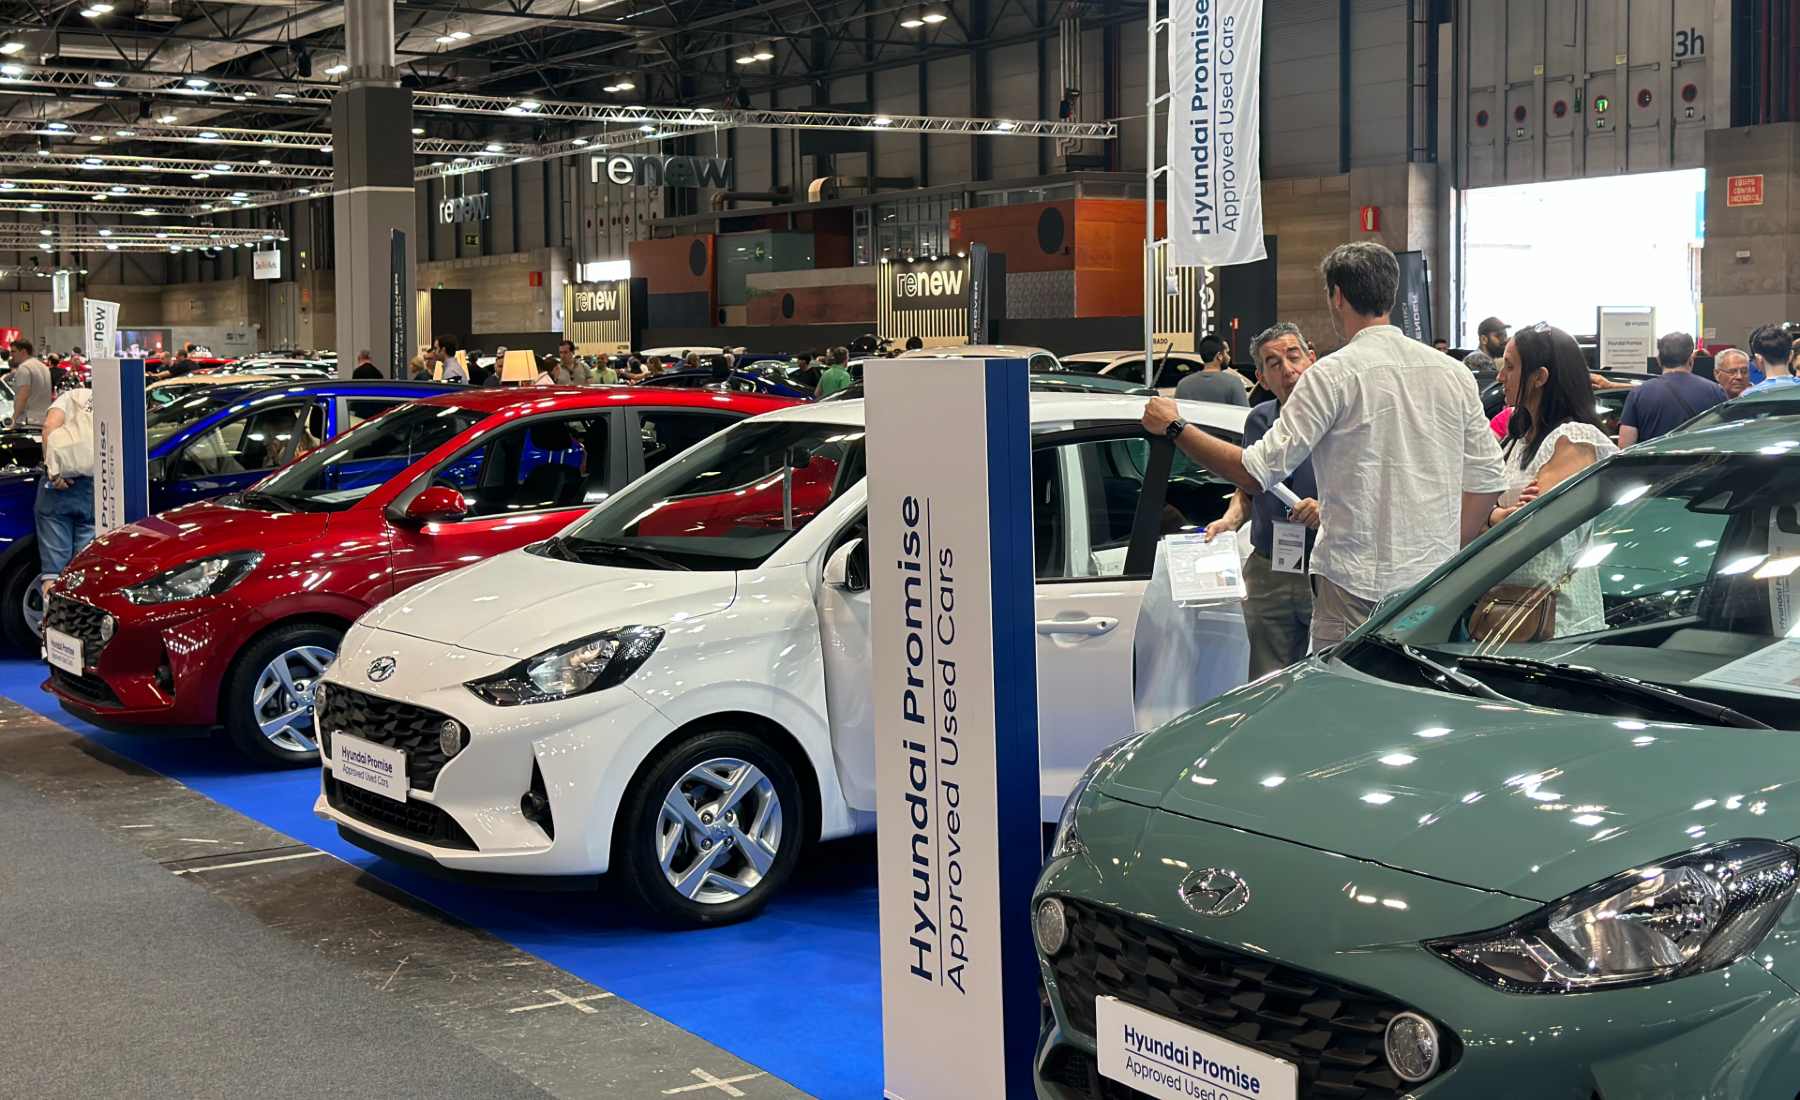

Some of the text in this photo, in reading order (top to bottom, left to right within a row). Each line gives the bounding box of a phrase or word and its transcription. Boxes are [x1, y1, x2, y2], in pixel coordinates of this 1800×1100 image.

[1674, 28, 1705, 57] 3h
[1190, 0, 1214, 235] Hyundai Promise
[1219, 16, 1240, 232] Approved Used Cars
[590, 154, 729, 189] renew
[575, 289, 617, 313] renew
[897, 269, 963, 297] renew
[99, 421, 109, 528] Promise
[342, 746, 393, 773] Hyundai Promise
[897, 496, 936, 982] Hyundai Promise
[377, 775, 389, 788] Cars
[936, 547, 968, 994] Approved Used Cars
[1124, 1024, 1261, 1095] Hyundai Promise
[1125, 1055, 1217, 1100] Approved Used
